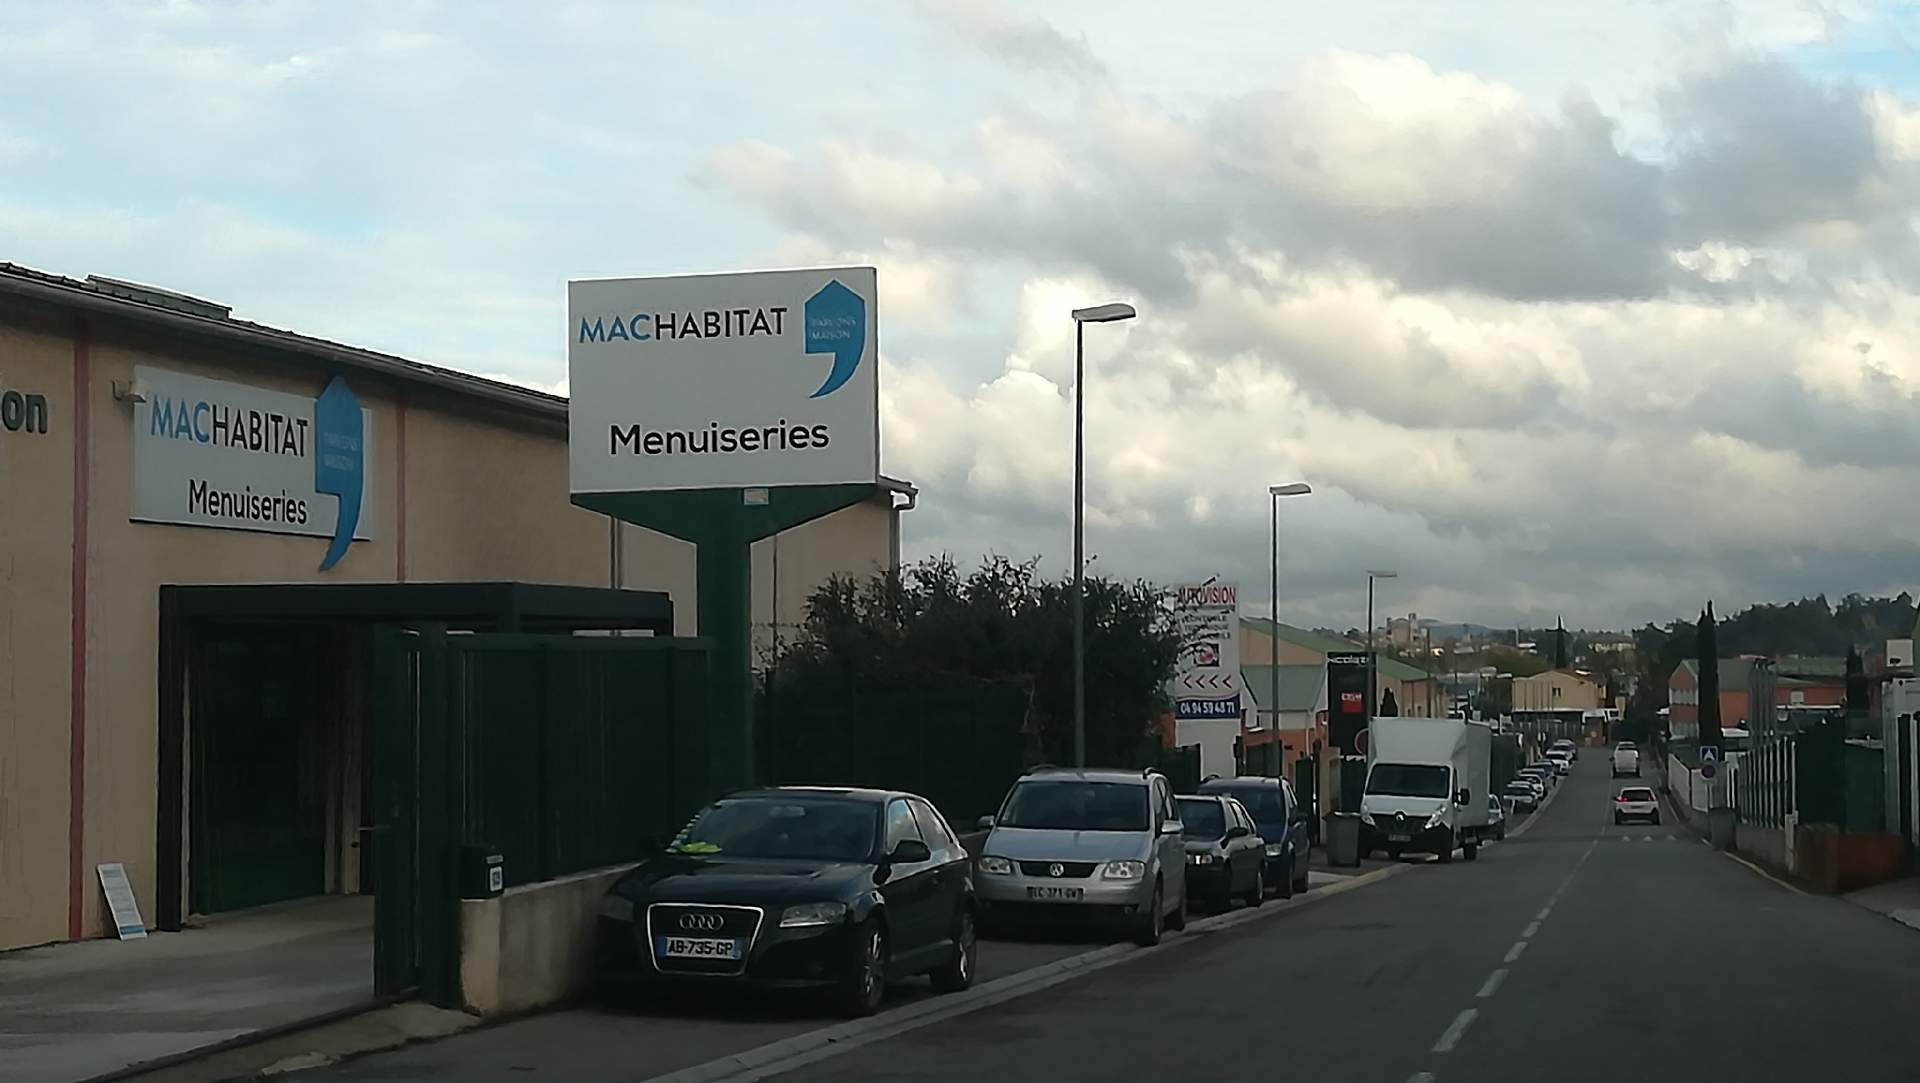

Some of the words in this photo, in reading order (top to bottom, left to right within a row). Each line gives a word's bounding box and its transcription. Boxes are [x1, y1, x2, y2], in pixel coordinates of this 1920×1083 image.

[579, 307, 787, 343] MACHABITAT
[150, 394, 308, 457] MACHABITAT
[610, 420, 829, 455] Menuiseries
[189, 479, 307, 525] Menuiseries
[1177, 587, 1236, 604] AUTOVISION
